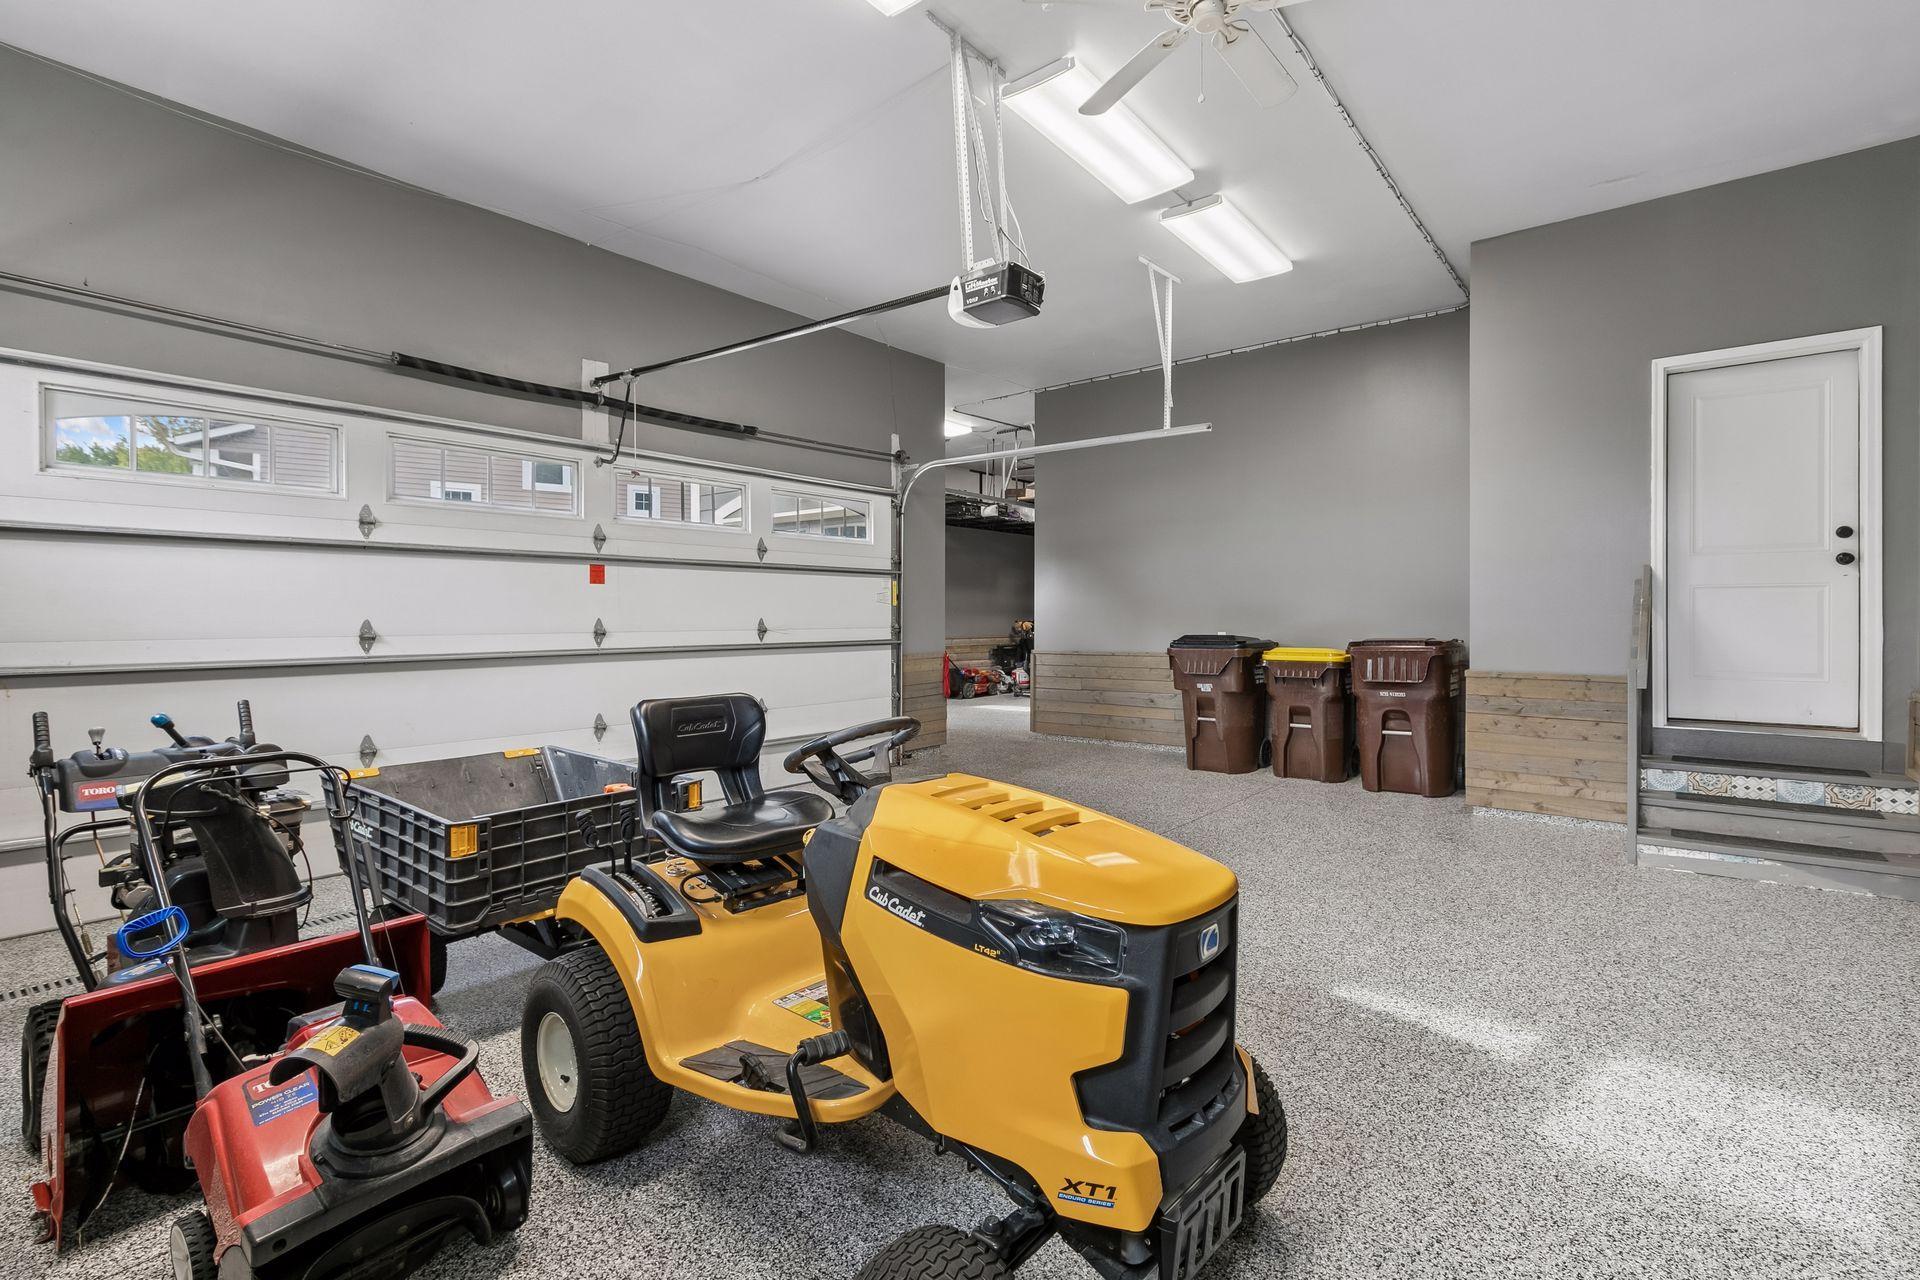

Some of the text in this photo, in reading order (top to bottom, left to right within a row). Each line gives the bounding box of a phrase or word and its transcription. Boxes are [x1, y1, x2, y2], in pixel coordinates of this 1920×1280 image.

[82, 786, 116, 796] TORO
[869, 886, 926, 926] Cub Cadet
[251, 1092, 283, 1108] POWER
[284, 1081, 310, 1095] CLEAR
[1058, 1193, 1113, 1207] ENDURO SERIES
[1059, 1177, 1117, 1200] XT1
